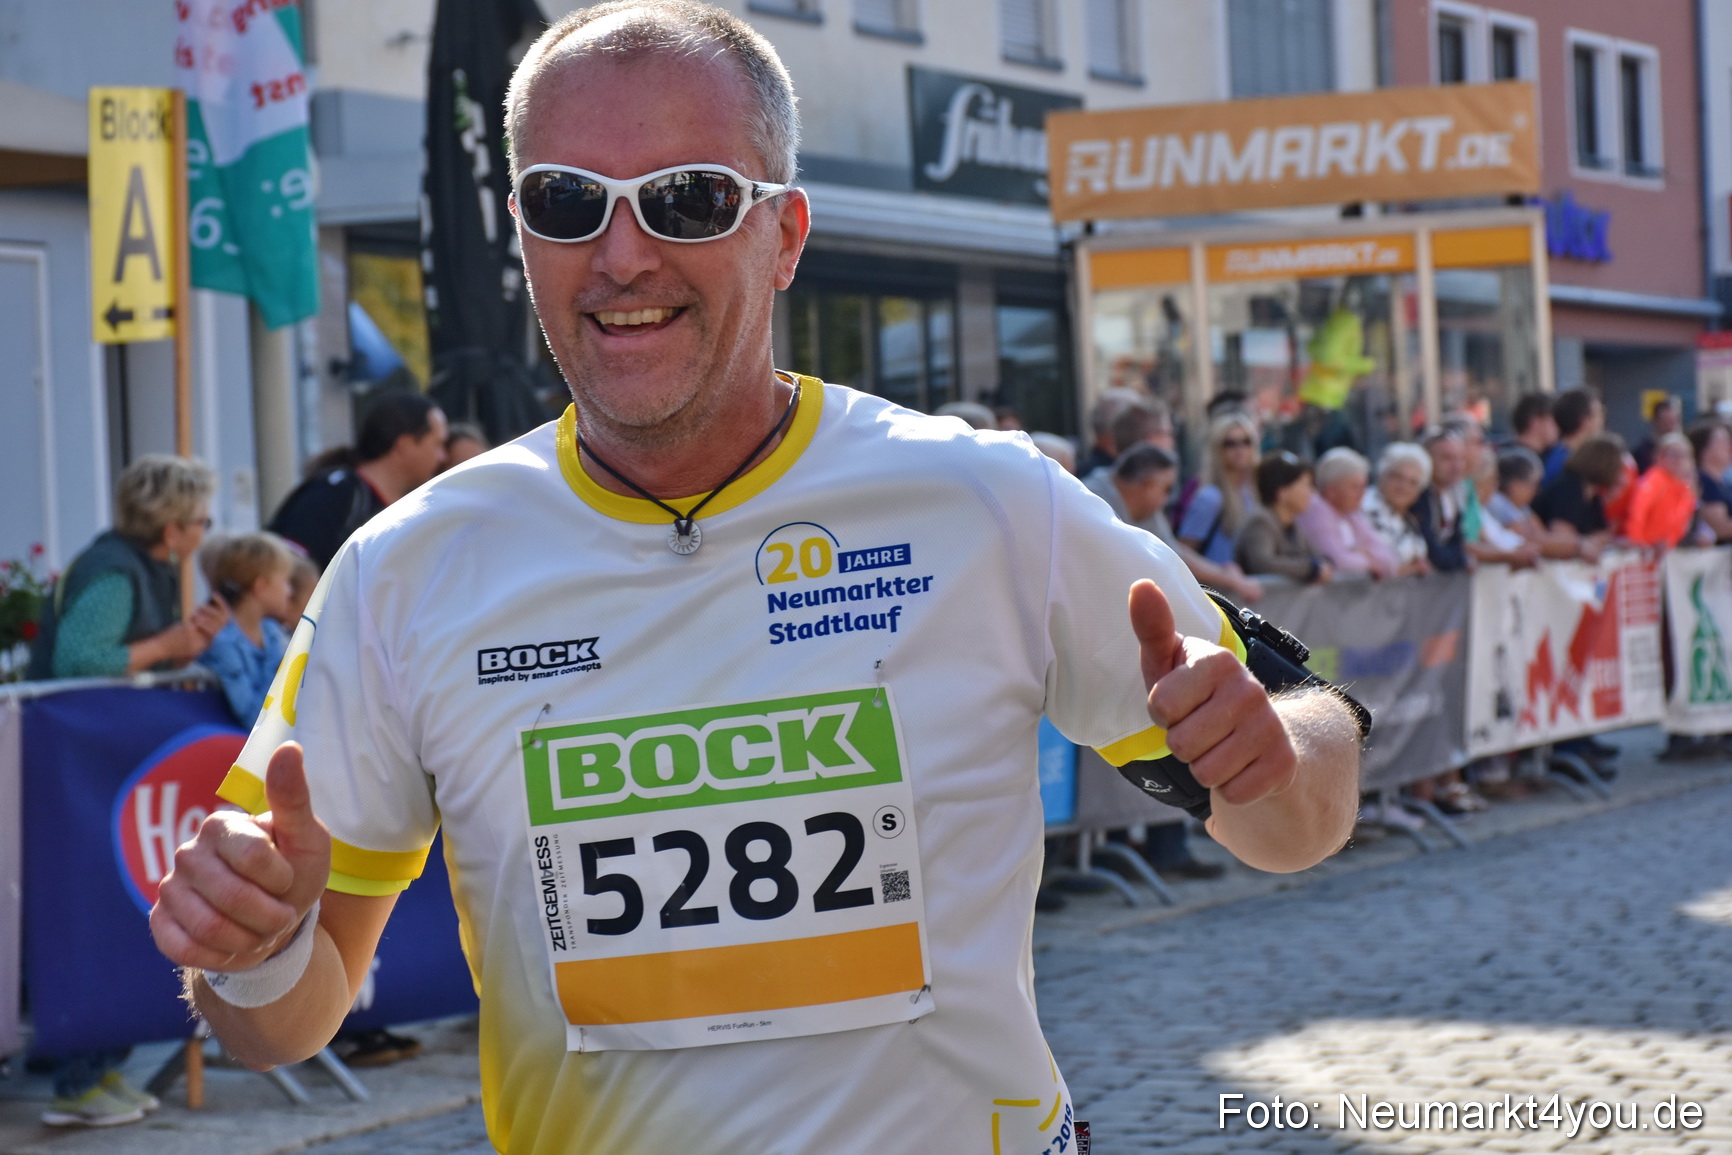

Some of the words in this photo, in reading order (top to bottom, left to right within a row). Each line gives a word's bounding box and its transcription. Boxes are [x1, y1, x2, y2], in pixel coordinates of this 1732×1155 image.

[101, 97, 173, 141] Block
[113, 164, 162, 284] A
[765, 536, 833, 584] 20
[845, 548, 905, 571] JAHRE
[767, 575, 934, 614] Neumarkter
[769, 605, 902, 645] Stadtlauf
[478, 637, 600, 676] BOCK
[479, 673, 516, 685] inspired
[518, 672, 530, 682] by
[532, 670, 559, 680] smart
[560, 662, 602, 675] concepts
[548, 703, 873, 810] BOCK
[881, 813, 897, 831] S
[553, 834, 567, 888] ZEITMESSUNG
[578, 811, 875, 936] 5282
[563, 893, 577, 950] TRANSPONDER
[707, 1023, 731, 1031] HERVIS
[732, 1022, 755, 1030] FunRun
[1052, 1103, 1072, 1153] 2019
